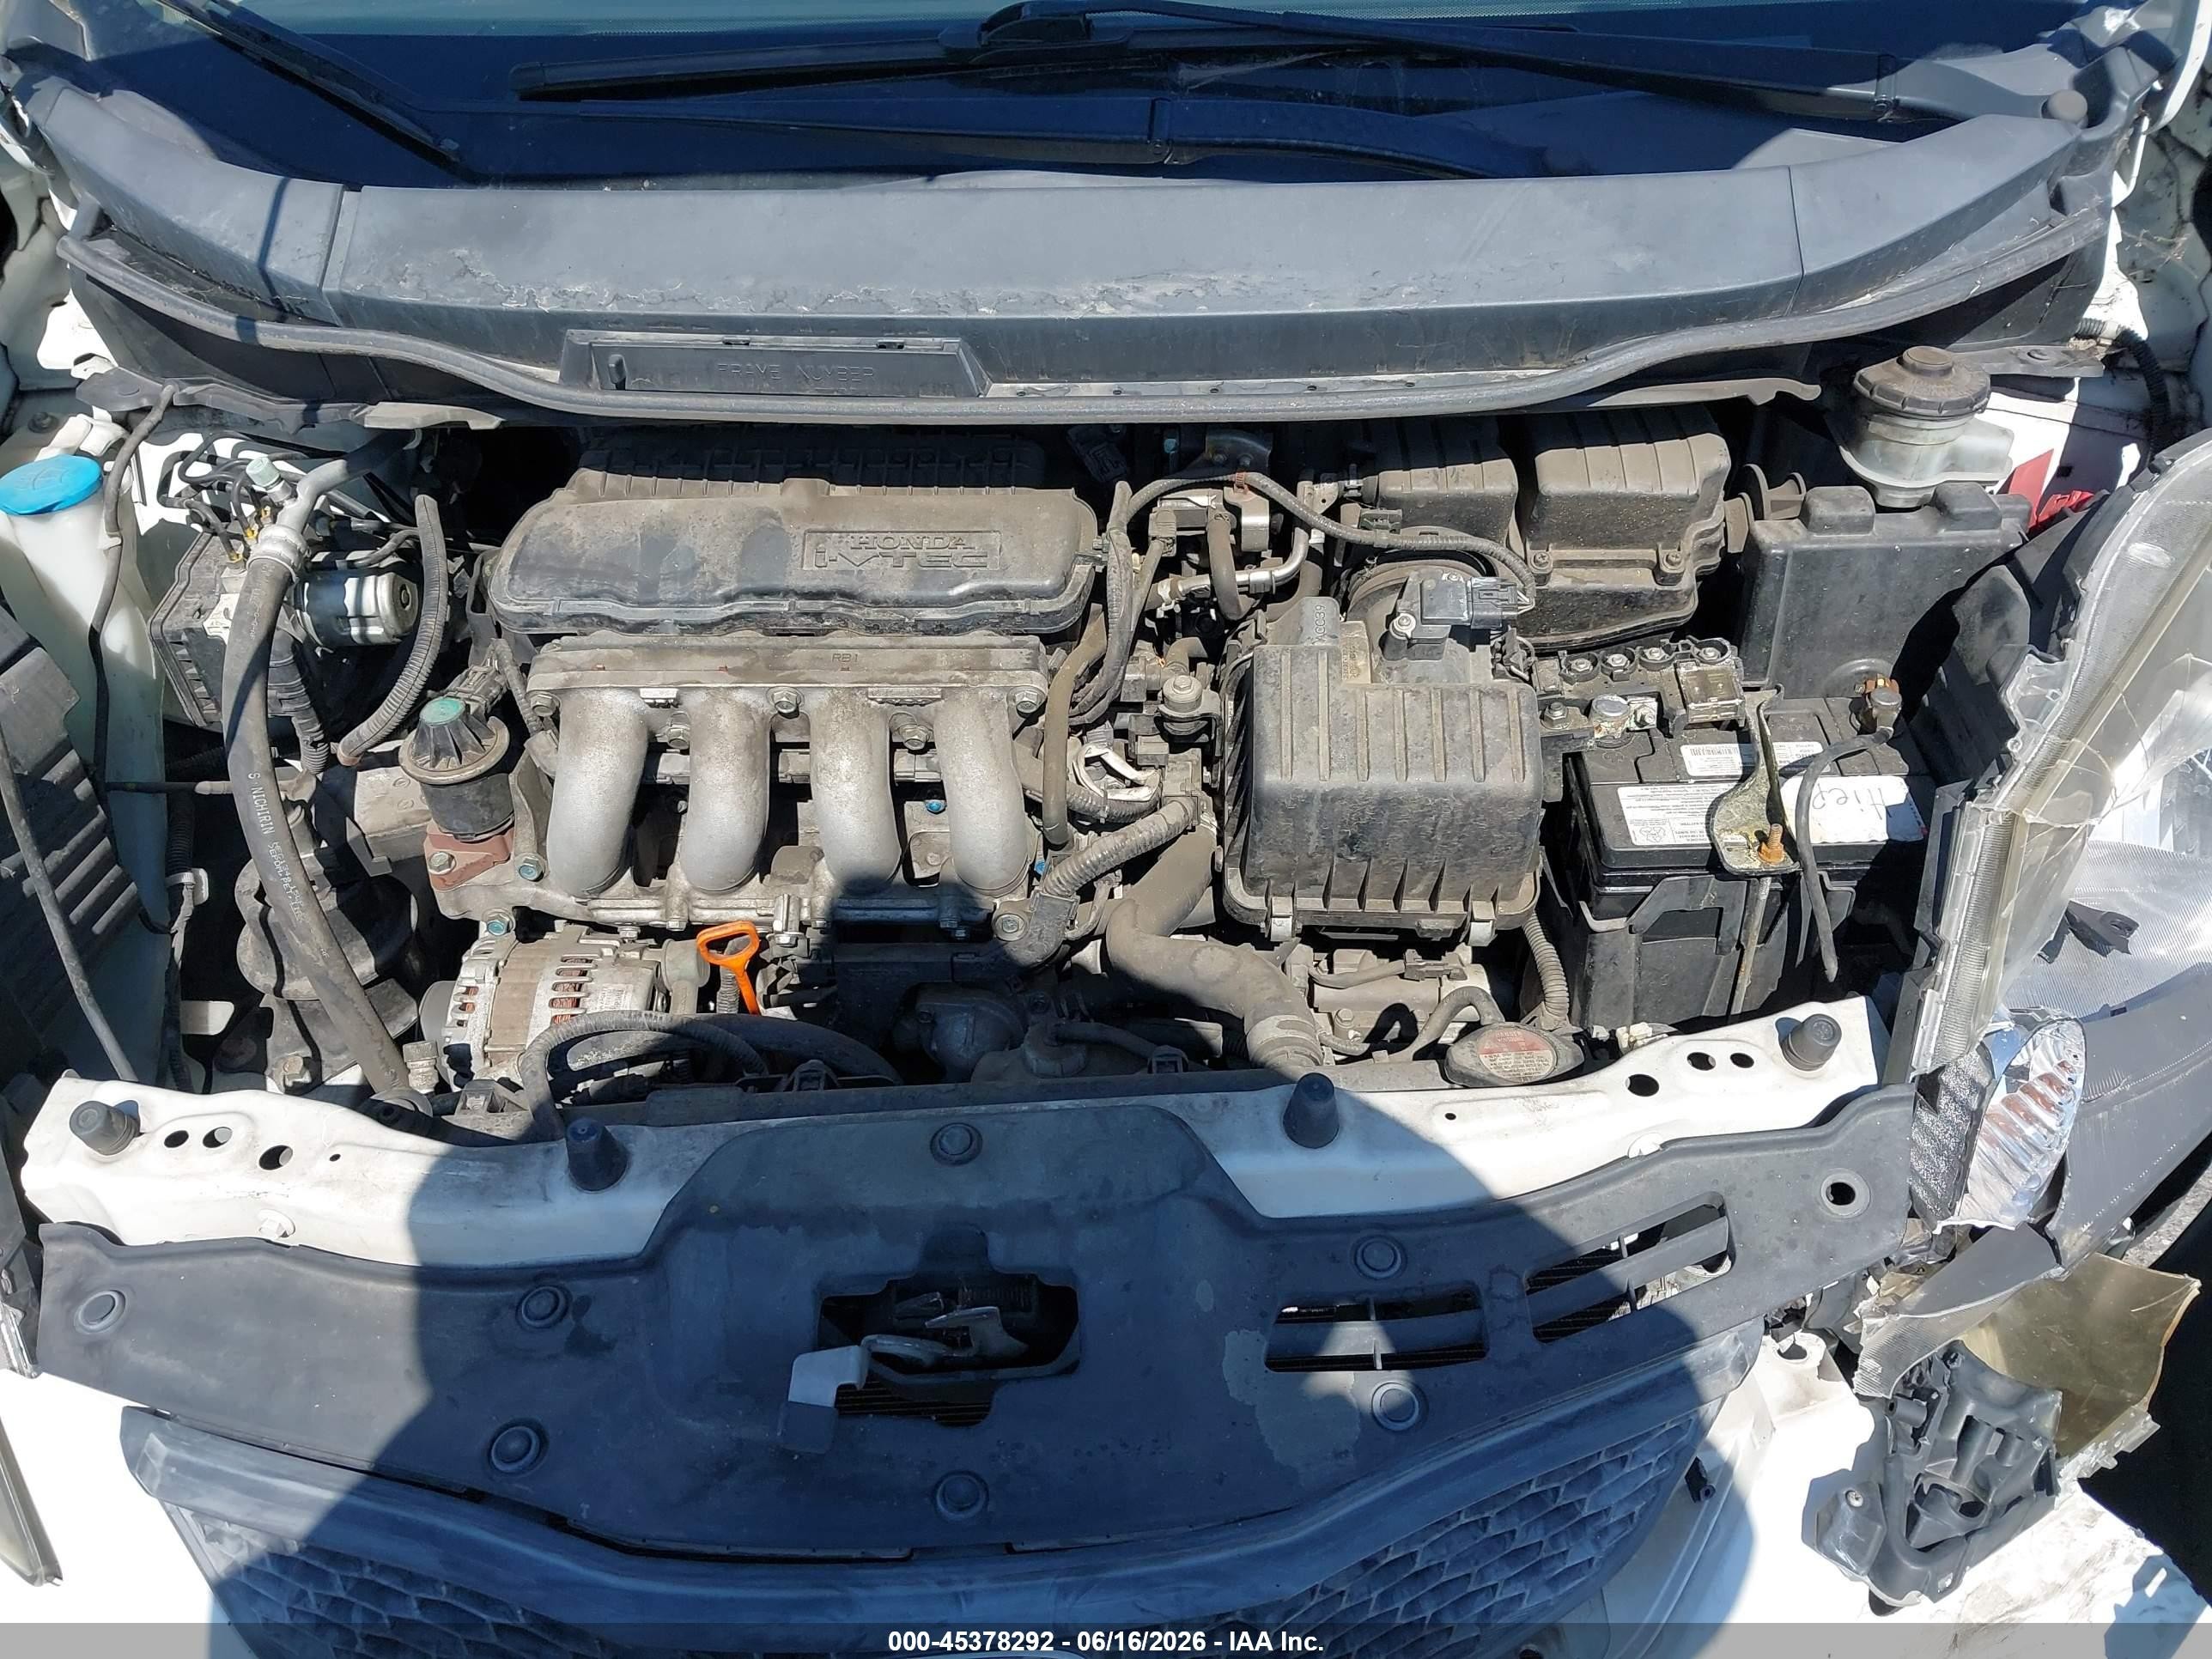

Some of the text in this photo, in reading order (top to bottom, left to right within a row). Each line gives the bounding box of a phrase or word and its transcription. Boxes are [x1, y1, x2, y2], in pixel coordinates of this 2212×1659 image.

[849, 535, 977, 550] HONDA
[814, 544, 989, 568] i-VTEC
[251, 785, 276, 836] NICHIRIN
